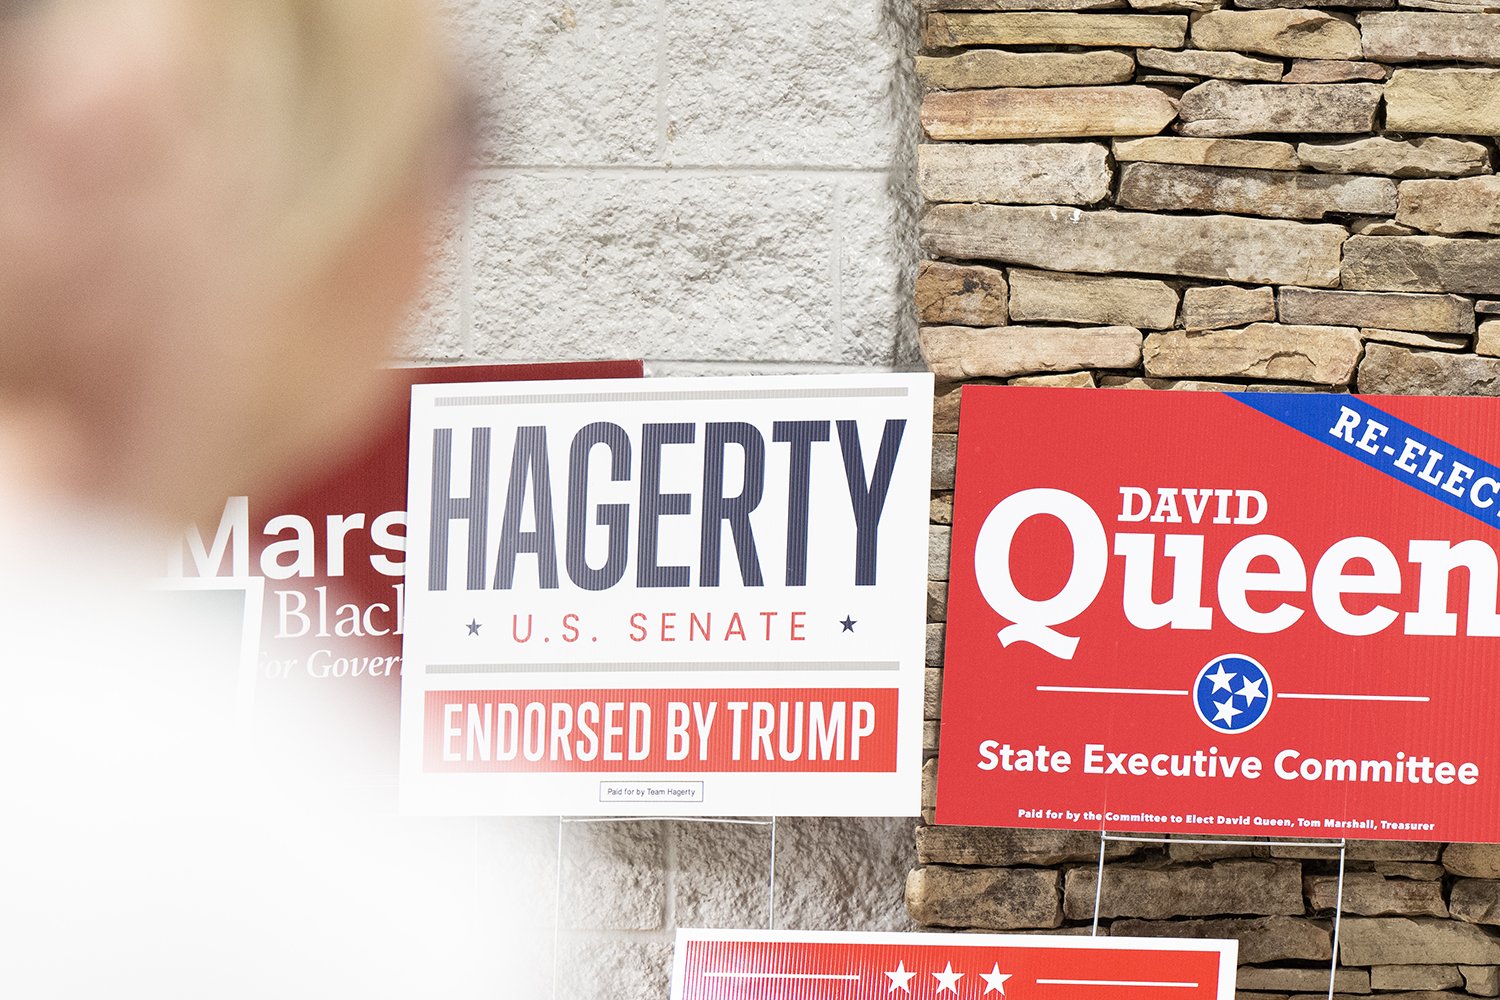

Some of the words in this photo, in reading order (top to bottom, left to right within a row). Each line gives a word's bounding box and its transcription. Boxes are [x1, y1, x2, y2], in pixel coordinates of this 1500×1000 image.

[428, 419, 907, 591] HAGERTY
[1117, 486, 1268, 526] DAVID
[511, 613, 598, 643] U.S.
[629, 611, 807, 642] SENATE
[306, 649, 402, 678] Gover
[442, 701, 652, 762] ENDORSED
[666, 701, 718, 761] BY
[727, 700, 876, 761] TRUMP
[977, 740, 1072, 775] State
[1083, 743, 1263, 780] Executive
[1273, 750, 1479, 786] Committee
[607, 788, 622, 796] Paid
[624, 788, 634, 796] for
[636, 788, 645, 797] by
[647, 788, 665, 796] Team
[667, 788, 695, 797] Hagerty
[1018, 809, 1043, 819] Paid
[1045, 810, 1063, 820] for
[1066, 811, 1080, 822] by
[1083, 811, 1102, 821] the
[1105, 812, 1167, 823] Committee
[1170, 814, 1182, 824] to
[1186, 814, 1214, 824] Elect
[1217, 815, 1250, 825] David
[1253, 816, 1295, 828] Queen,
[1297, 818, 1321, 827] Tom
[1324, 819, 1378, 830] Marshall,
[1380, 820, 1435, 831] Treasurer
